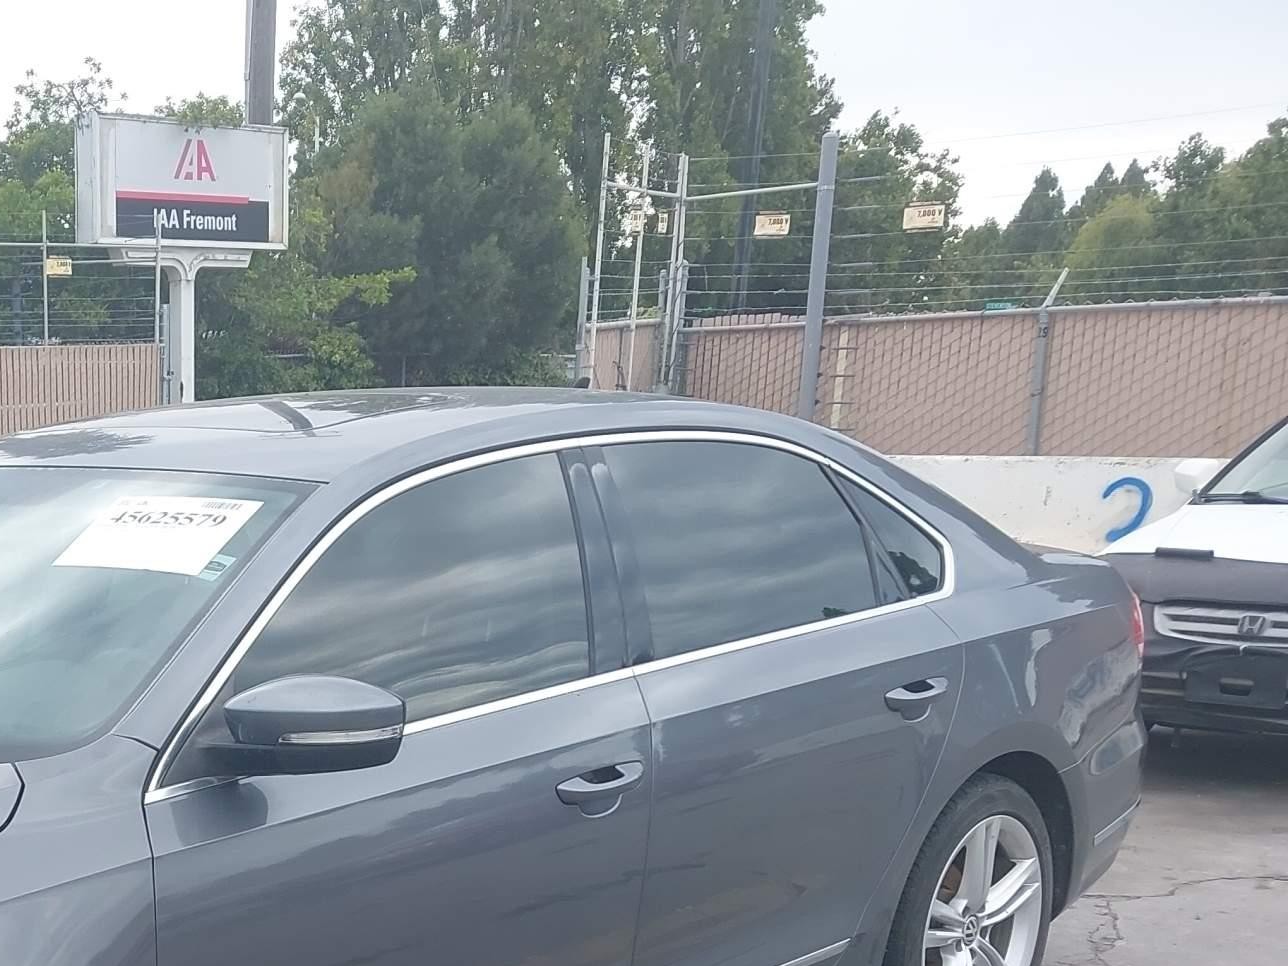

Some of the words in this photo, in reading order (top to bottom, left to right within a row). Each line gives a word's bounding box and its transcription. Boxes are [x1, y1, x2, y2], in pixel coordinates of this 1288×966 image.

[153, 207, 179, 229] IAA
[183, 209, 237, 231] Fremont
[111, 511, 227, 527] 45625579
